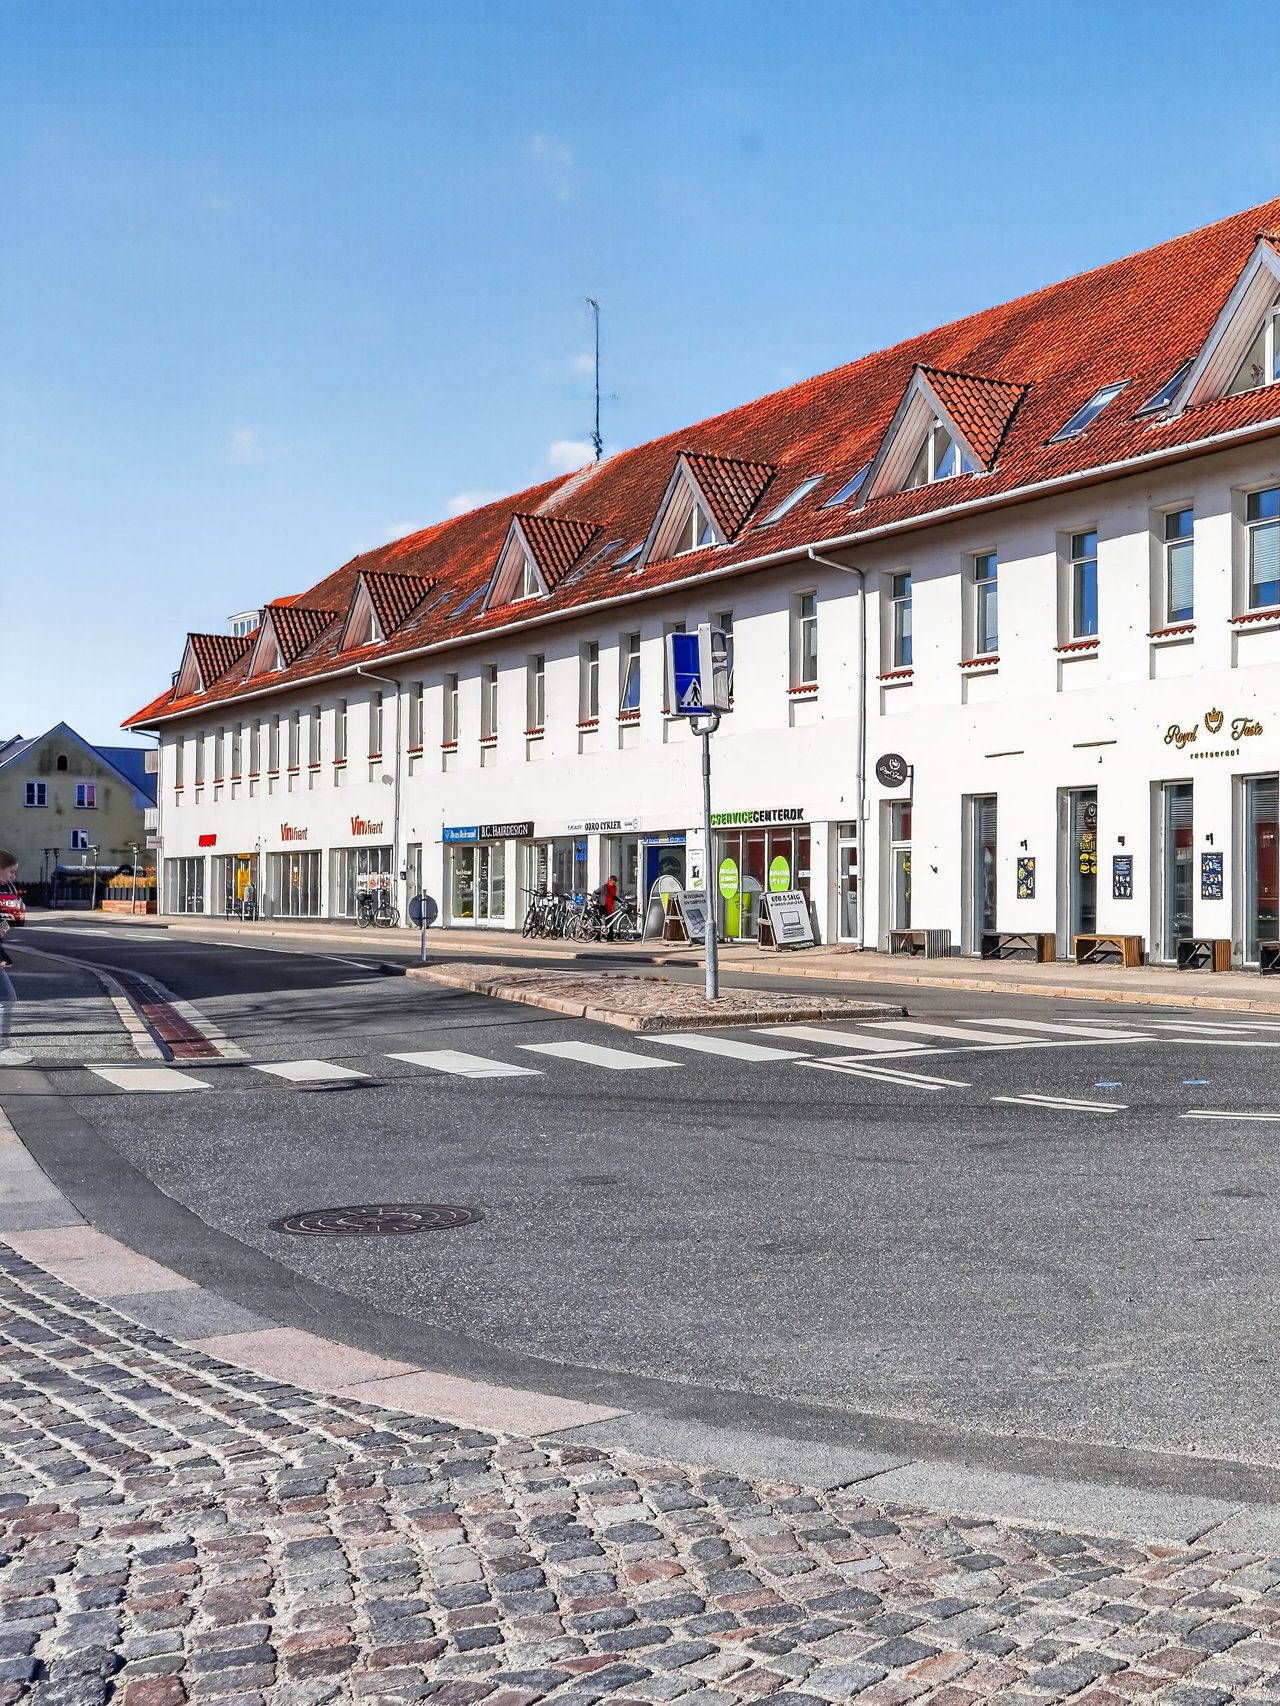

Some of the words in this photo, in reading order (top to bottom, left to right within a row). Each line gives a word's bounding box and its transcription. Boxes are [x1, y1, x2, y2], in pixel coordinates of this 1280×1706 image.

[1163, 723, 1199, 750] Royal
[1230, 717, 1264, 741] Taste
[710, 807, 804, 826] CSERVICECENTERDK
[492, 823, 529, 837] HAIRDESIGN
